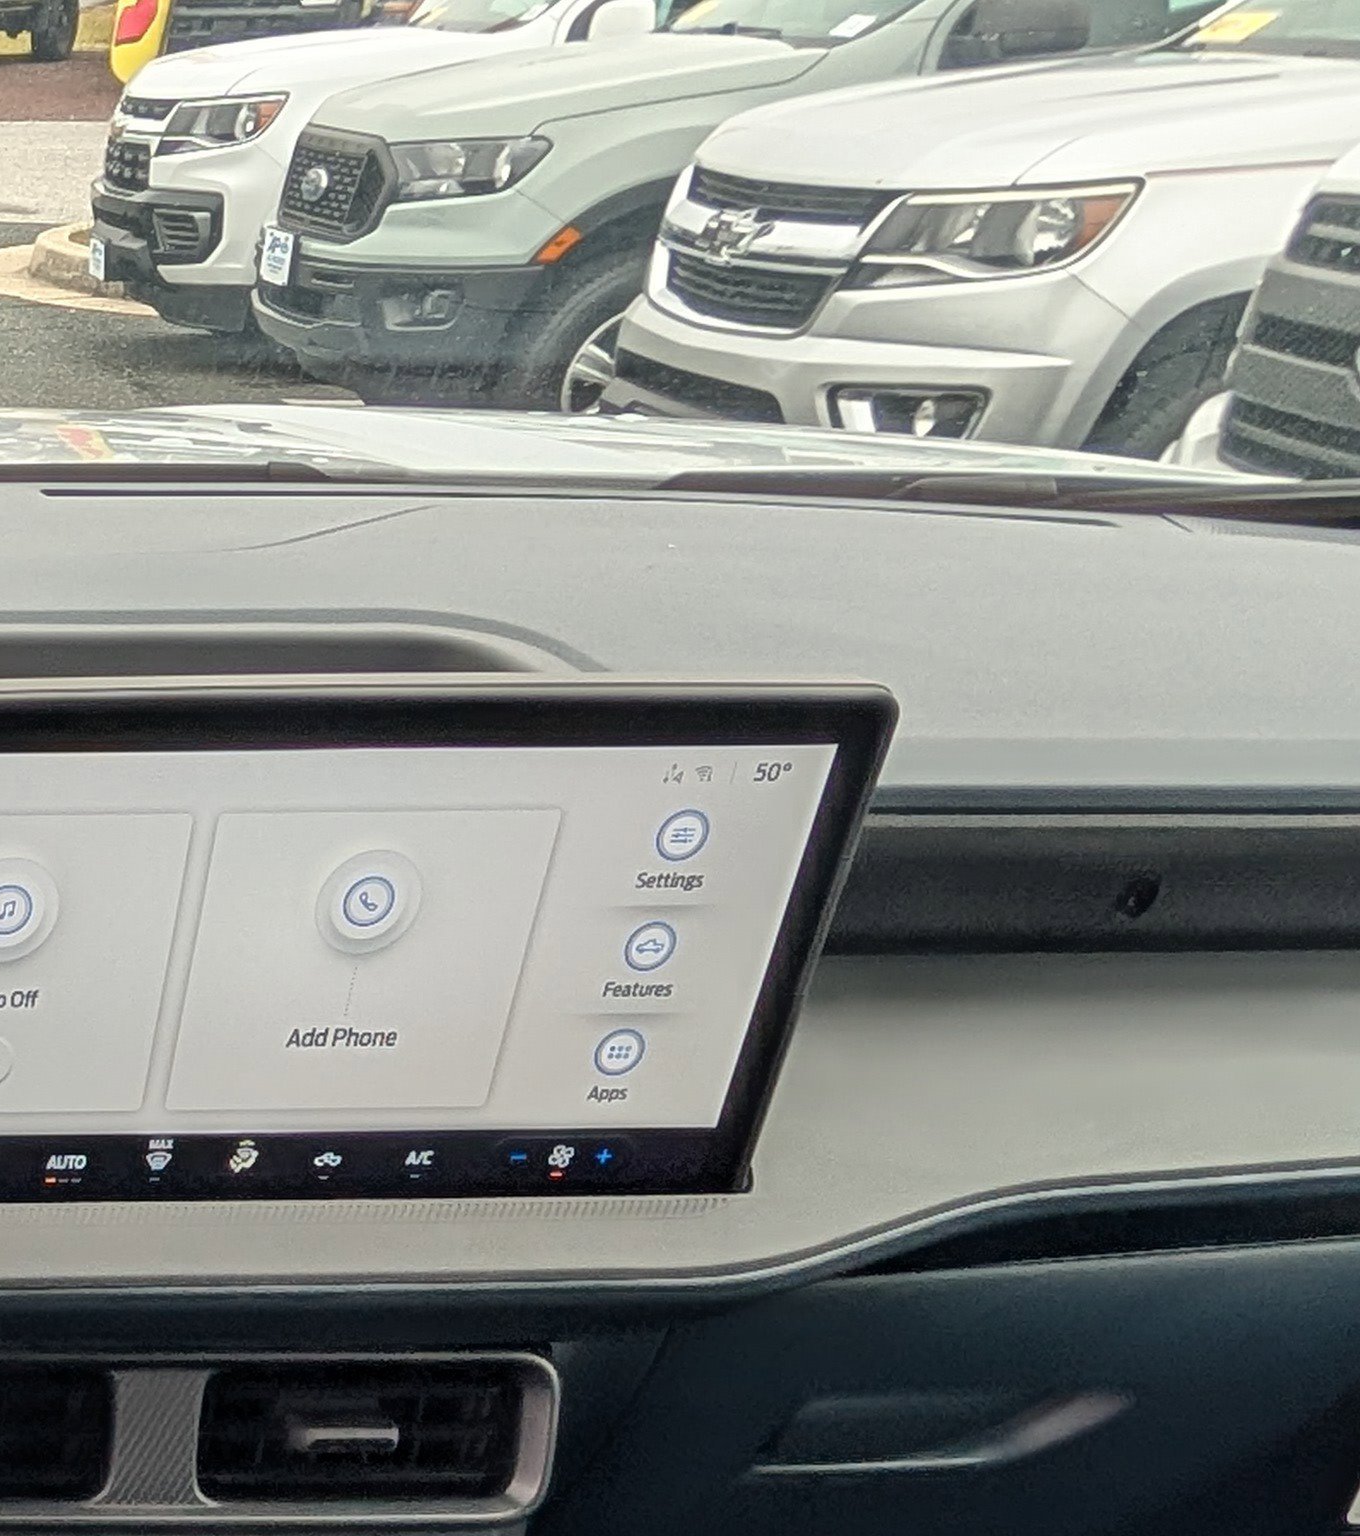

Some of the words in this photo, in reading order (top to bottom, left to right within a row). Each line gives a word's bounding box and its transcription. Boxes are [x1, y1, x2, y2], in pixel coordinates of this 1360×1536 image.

[752, 762, 793, 783] 50°
[635, 872, 704, 891] Settings
[602, 981, 673, 998] Features
[10, 989, 40, 1009] Off
[286, 1028, 327, 1048] Add
[331, 1028, 398, 1048] Phone
[587, 1085, 628, 1103] Apps
[148, 1139, 174, 1150] MAX
[45, 1154, 88, 1171] AUTO
[405, 1149, 436, 1166] A/C
